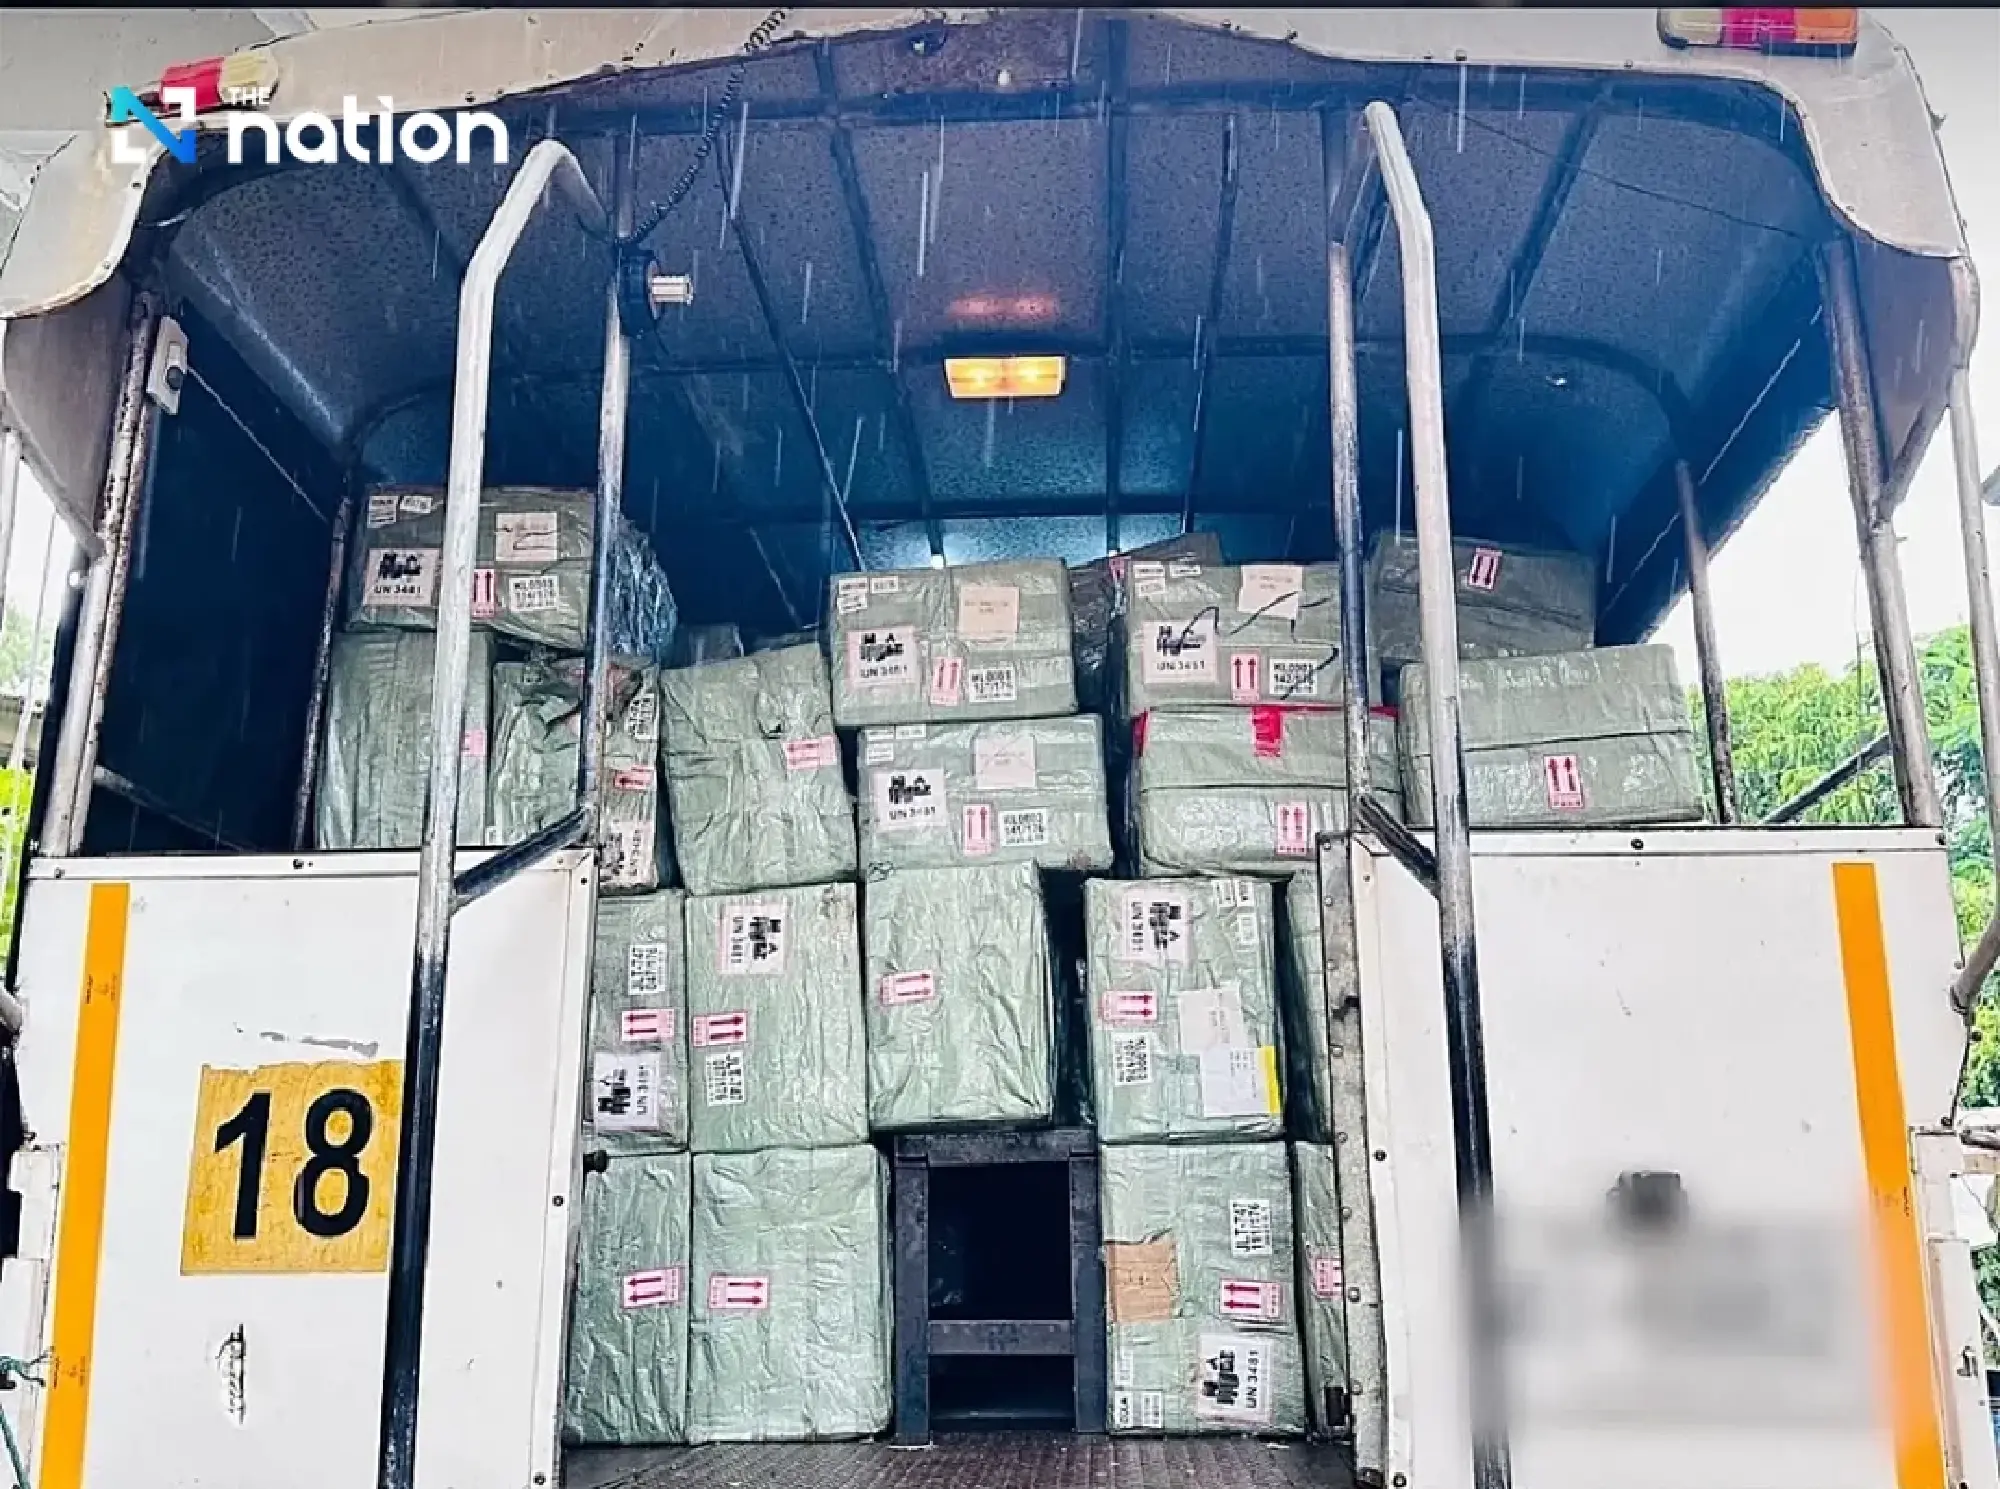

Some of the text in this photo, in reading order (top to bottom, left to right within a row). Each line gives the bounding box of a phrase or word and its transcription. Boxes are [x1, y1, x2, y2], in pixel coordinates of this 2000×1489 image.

[373, 585, 391, 594] UN
[860, 667, 878, 678] UN
[1156, 660, 1176, 670] UN
[889, 810, 907, 820] UN
[1131, 901, 1144, 919] UN
[732, 916, 744, 934] UN
[636, 1095, 647, 1115] UN
[215, 1089, 373, 1239] 18
[1245, 1349, 1259, 1409] UN 3481
